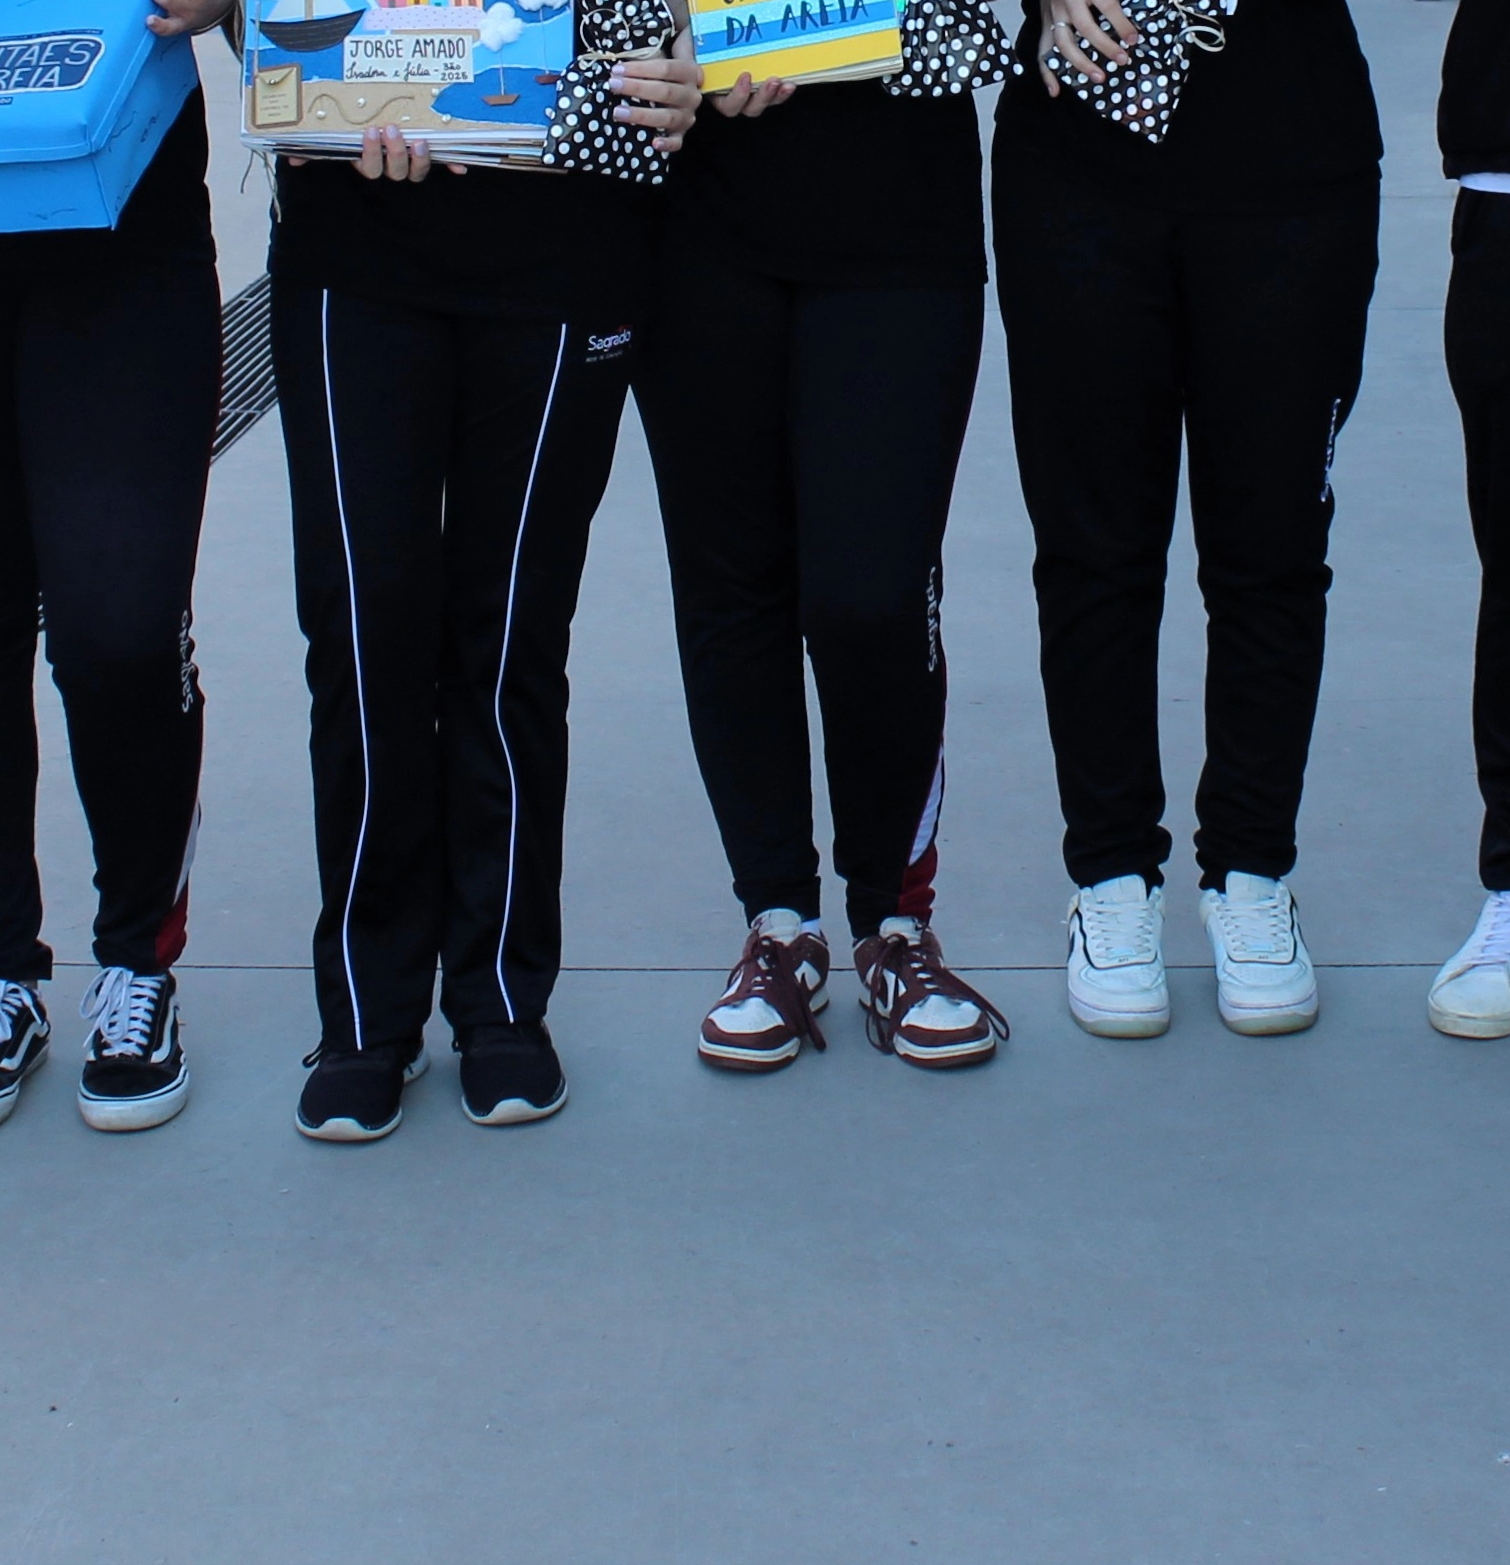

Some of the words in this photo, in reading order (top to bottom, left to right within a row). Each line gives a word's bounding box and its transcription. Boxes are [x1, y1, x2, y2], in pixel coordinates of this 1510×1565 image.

[726, 14, 762, 46] DA
[349, 39, 403, 58] JORGE
[411, 37, 466, 58] AMADO
[587, 329, 631, 352] Sagrado
